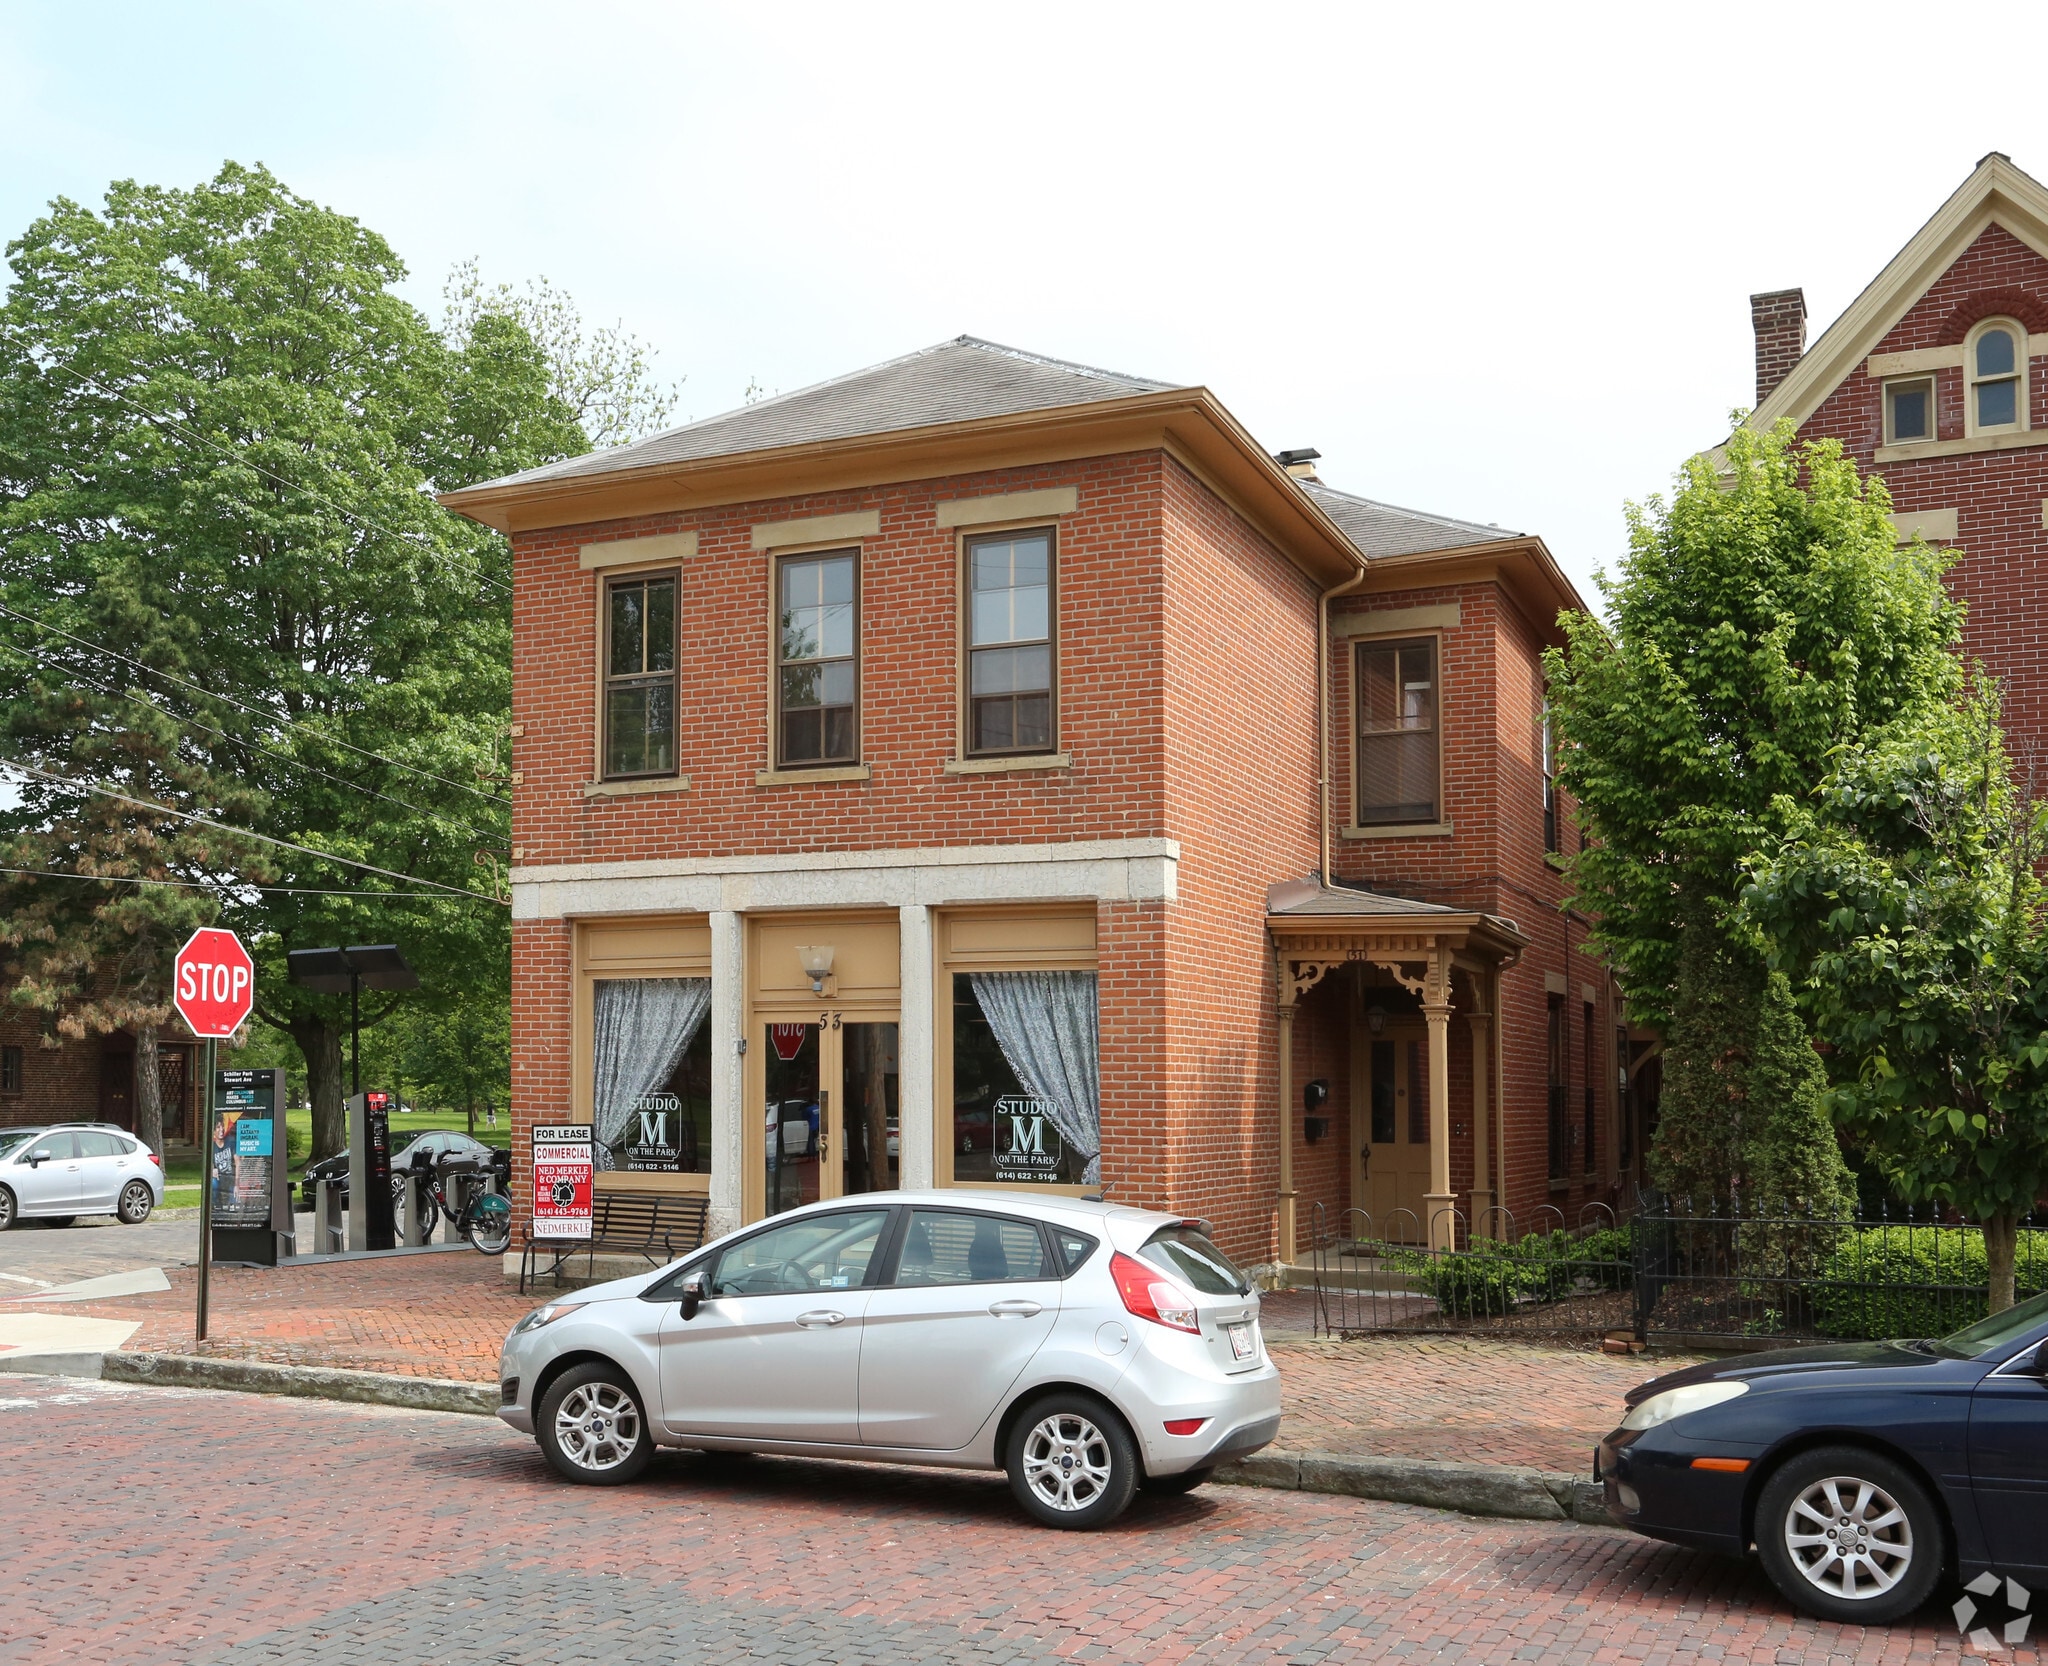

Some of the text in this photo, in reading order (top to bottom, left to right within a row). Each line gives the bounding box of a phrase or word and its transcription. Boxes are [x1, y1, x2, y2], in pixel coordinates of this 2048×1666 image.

[180, 961, 249, 1003] STOP
[819, 1013, 842, 1030] 53
[629, 1097, 679, 1110] STUDIO
[997, 1100, 1058, 1114] STUDIO
[536, 1129, 589, 1138] FOR LEASE
[637, 1112, 669, 1147] M
[1008, 1116, 1046, 1155] M
[536, 1147, 590, 1159] COMMERCIAL
[656, 1148, 677, 1156] PARK
[998, 1154, 1055, 1164] ON THE PARK
[538, 1166, 589, 1175] NED MERKLE
[996, 1172, 1016, 1180] (614)
[1017, 1172, 1032, 1180] 622
[1038, 1173, 1057, 1181] 5146
[539, 1175, 587, 1183] & COMPANY
[535, 1222, 590, 1234] NEDMERKLE
